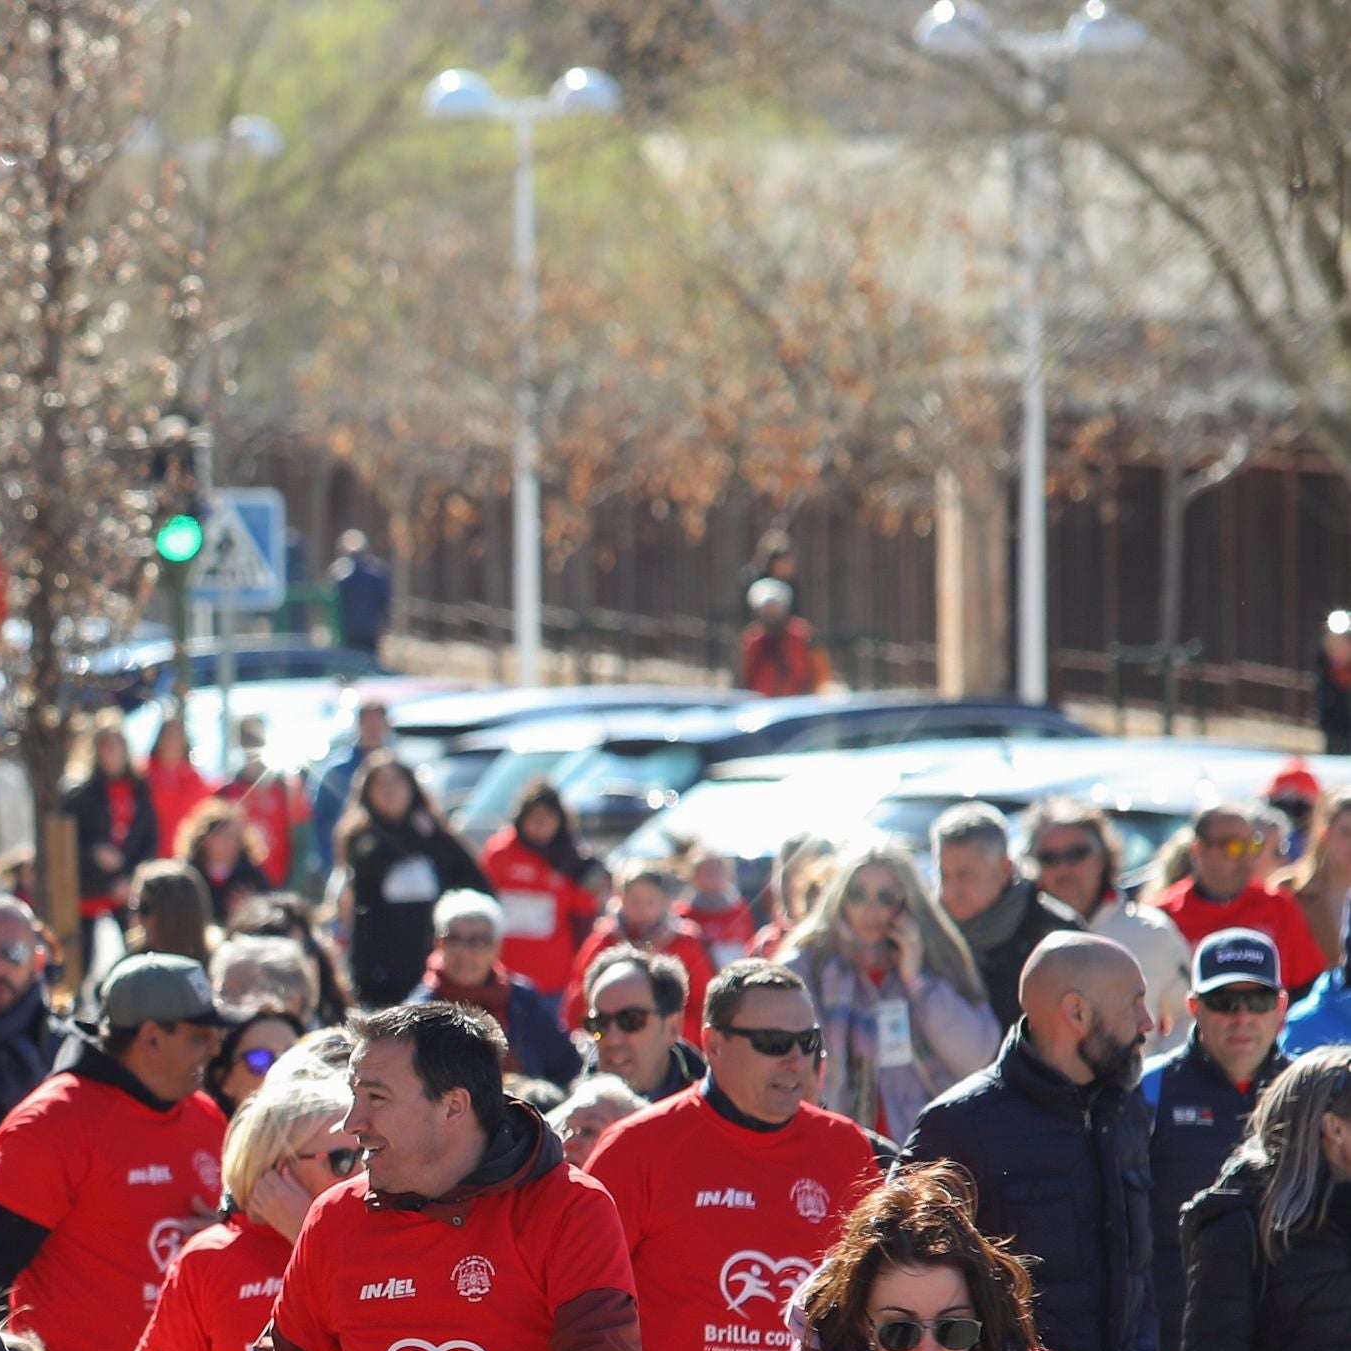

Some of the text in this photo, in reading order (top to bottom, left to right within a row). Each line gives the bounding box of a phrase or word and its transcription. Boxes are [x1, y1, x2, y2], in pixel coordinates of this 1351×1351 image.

[695, 1187, 756, 1210] INAEL
[359, 1278, 416, 1300] INAEL
[704, 1323, 761, 1345] Brilla
